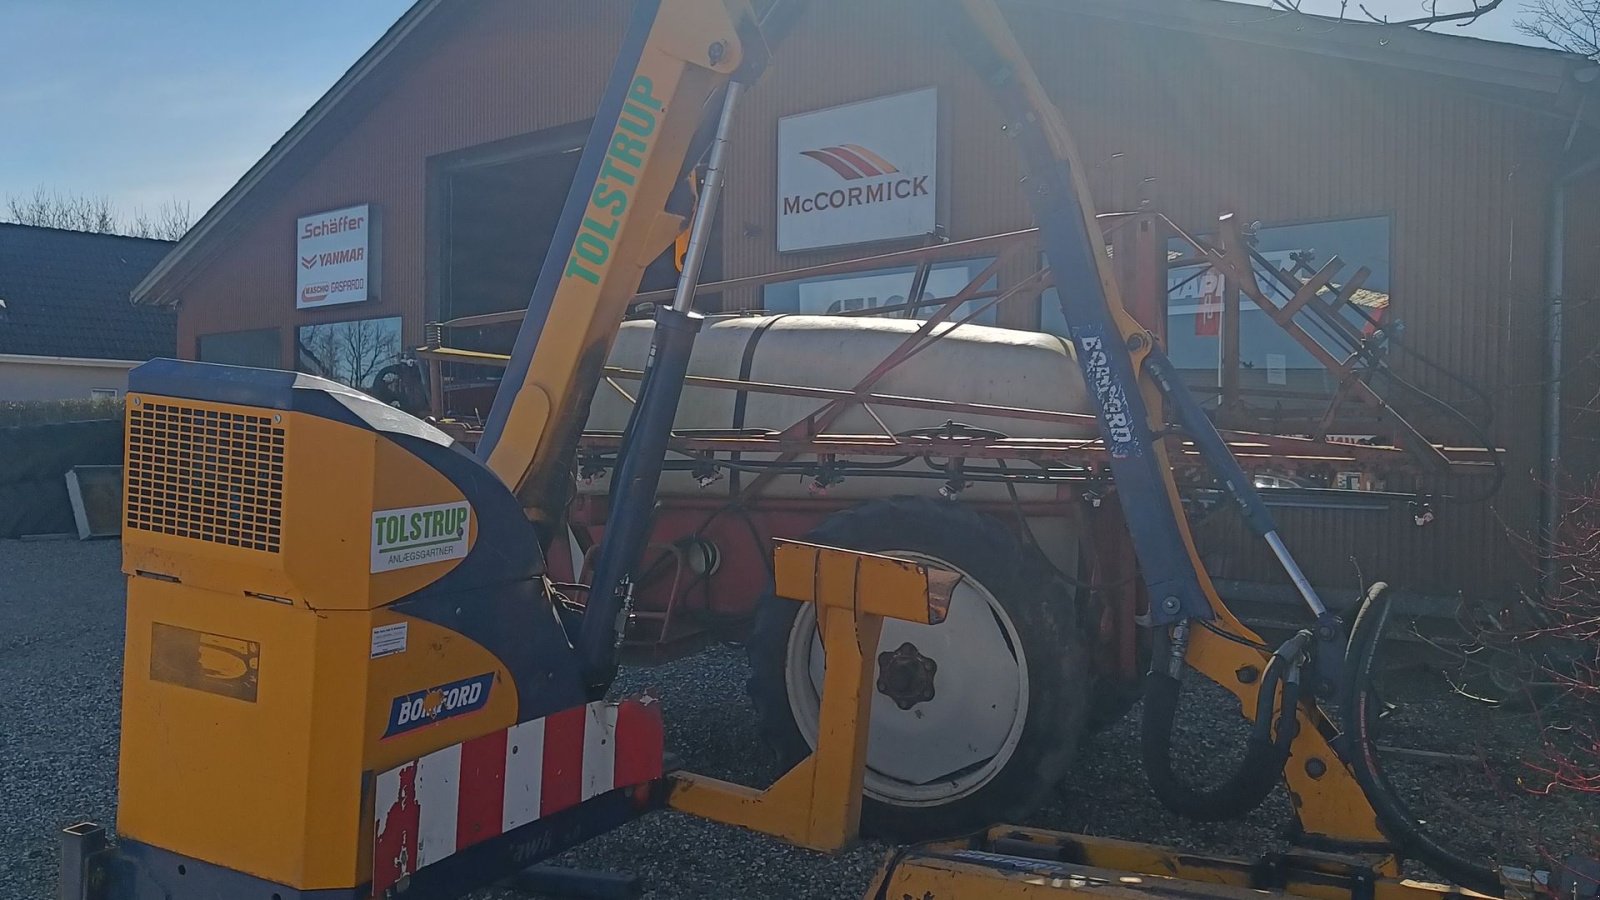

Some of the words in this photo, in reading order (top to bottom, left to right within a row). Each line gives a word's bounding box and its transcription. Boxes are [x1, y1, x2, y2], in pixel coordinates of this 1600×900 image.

[565, 75, 664, 286] TOLSTRUP
[783, 175, 929, 216] McCORMICK
[301, 215, 364, 239] Schäffer
[319, 247, 364, 267] YANMAR
[331, 278, 364, 293] GASPARDO
[375, 507, 468, 546] TOLSTRUP
[388, 545, 454, 565] ANLÆGSGARTNER
[397, 682, 482, 726] BOFORD
